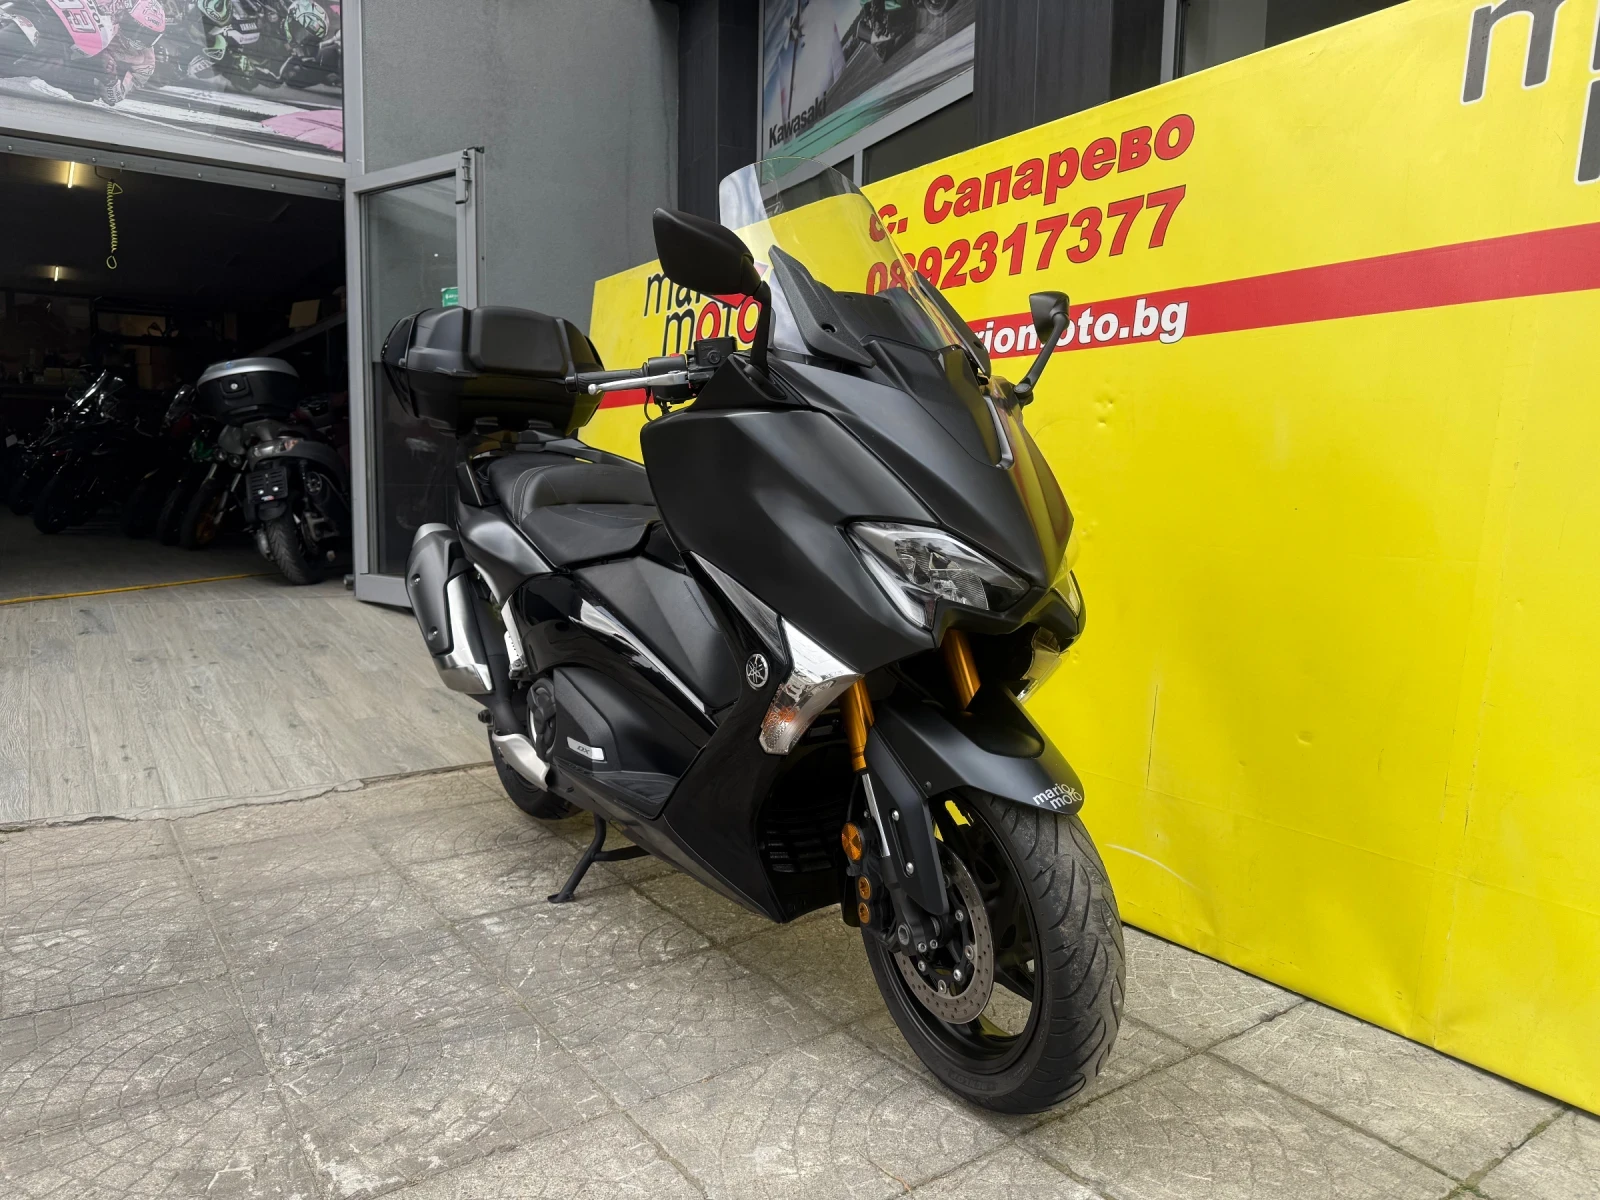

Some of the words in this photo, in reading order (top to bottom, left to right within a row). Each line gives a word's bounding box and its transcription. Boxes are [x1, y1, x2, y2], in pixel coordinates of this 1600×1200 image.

[769, 91, 827, 149] Kawasaki
[923, 113, 1195, 225] Сапарево
[1032, 783, 1071, 805] mario
[1050, 787, 1082, 809] moto
